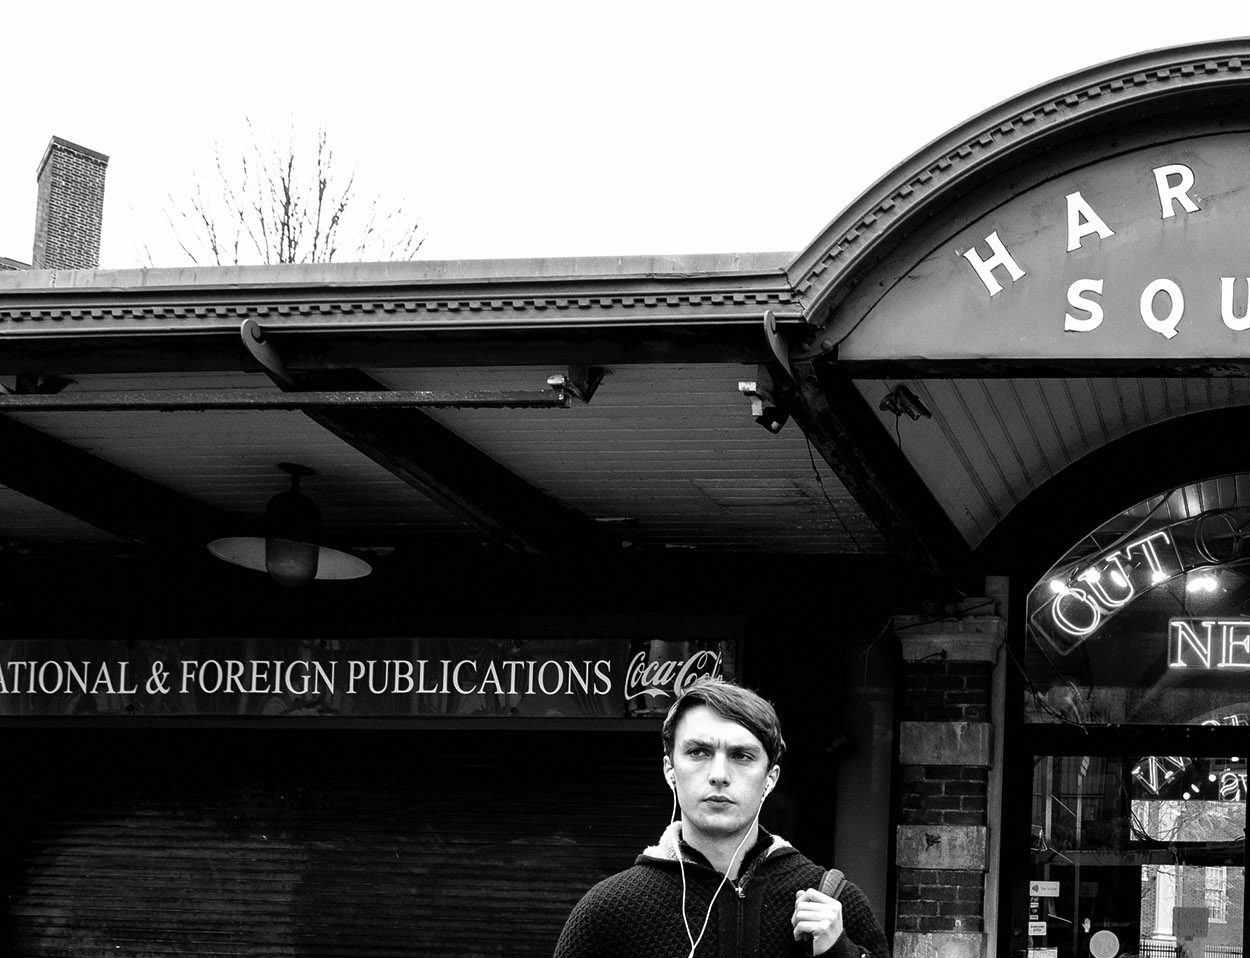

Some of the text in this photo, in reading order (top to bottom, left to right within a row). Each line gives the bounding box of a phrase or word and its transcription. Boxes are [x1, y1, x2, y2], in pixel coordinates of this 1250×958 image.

[1050, 530, 1171, 635] OUT
[145, 660, 171, 694] &
[179, 659, 338, 695] FOREIGN
[348, 659, 612, 696] PUBLICATIONS
